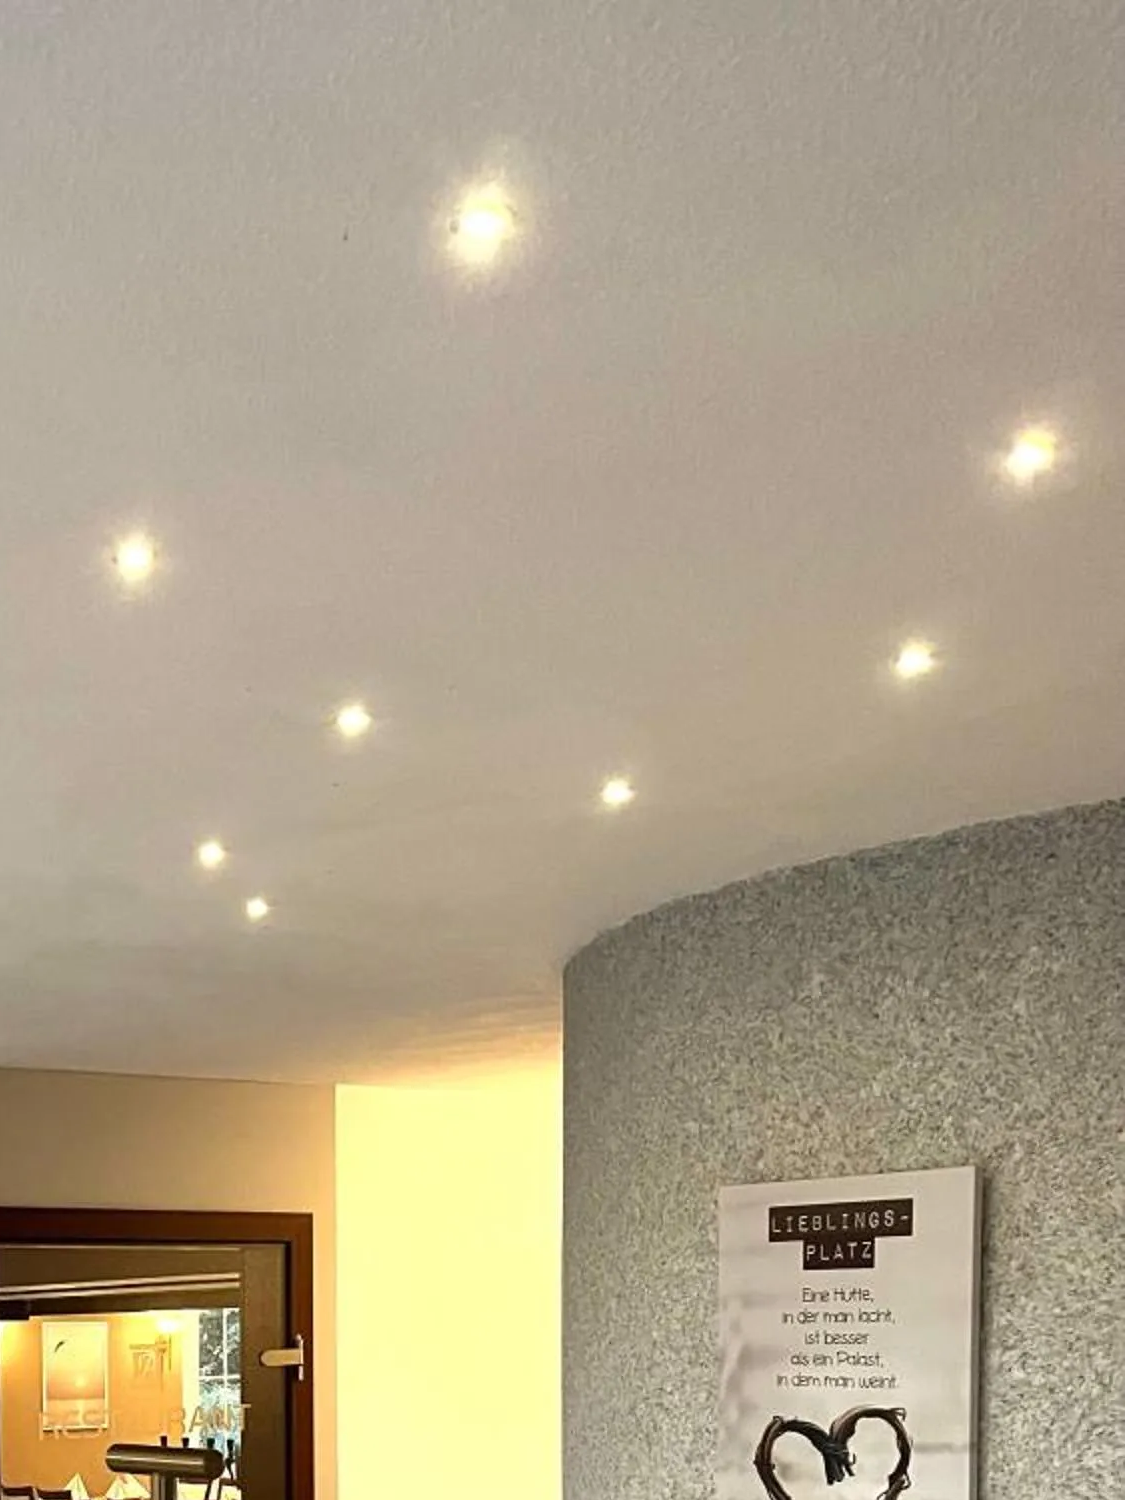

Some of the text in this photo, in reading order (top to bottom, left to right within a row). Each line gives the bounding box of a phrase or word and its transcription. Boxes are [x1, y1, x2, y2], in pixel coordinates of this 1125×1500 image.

[771, 1209, 909, 1233] LIEBLINGS-
[806, 1241, 872, 1261] PLATZ
[802, 1287, 830, 1302] Eine
[782, 1311, 794, 1324] in
[797, 1309, 819, 1324] der
[823, 1311, 854, 1324] man
[804, 1331, 870, 1345] ist besser
[790, 1350, 884, 1368] als ein Palast,
[777, 1374, 788, 1387] in
[791, 1373, 822, 1387] dem
[825, 1375, 855, 1388] man
